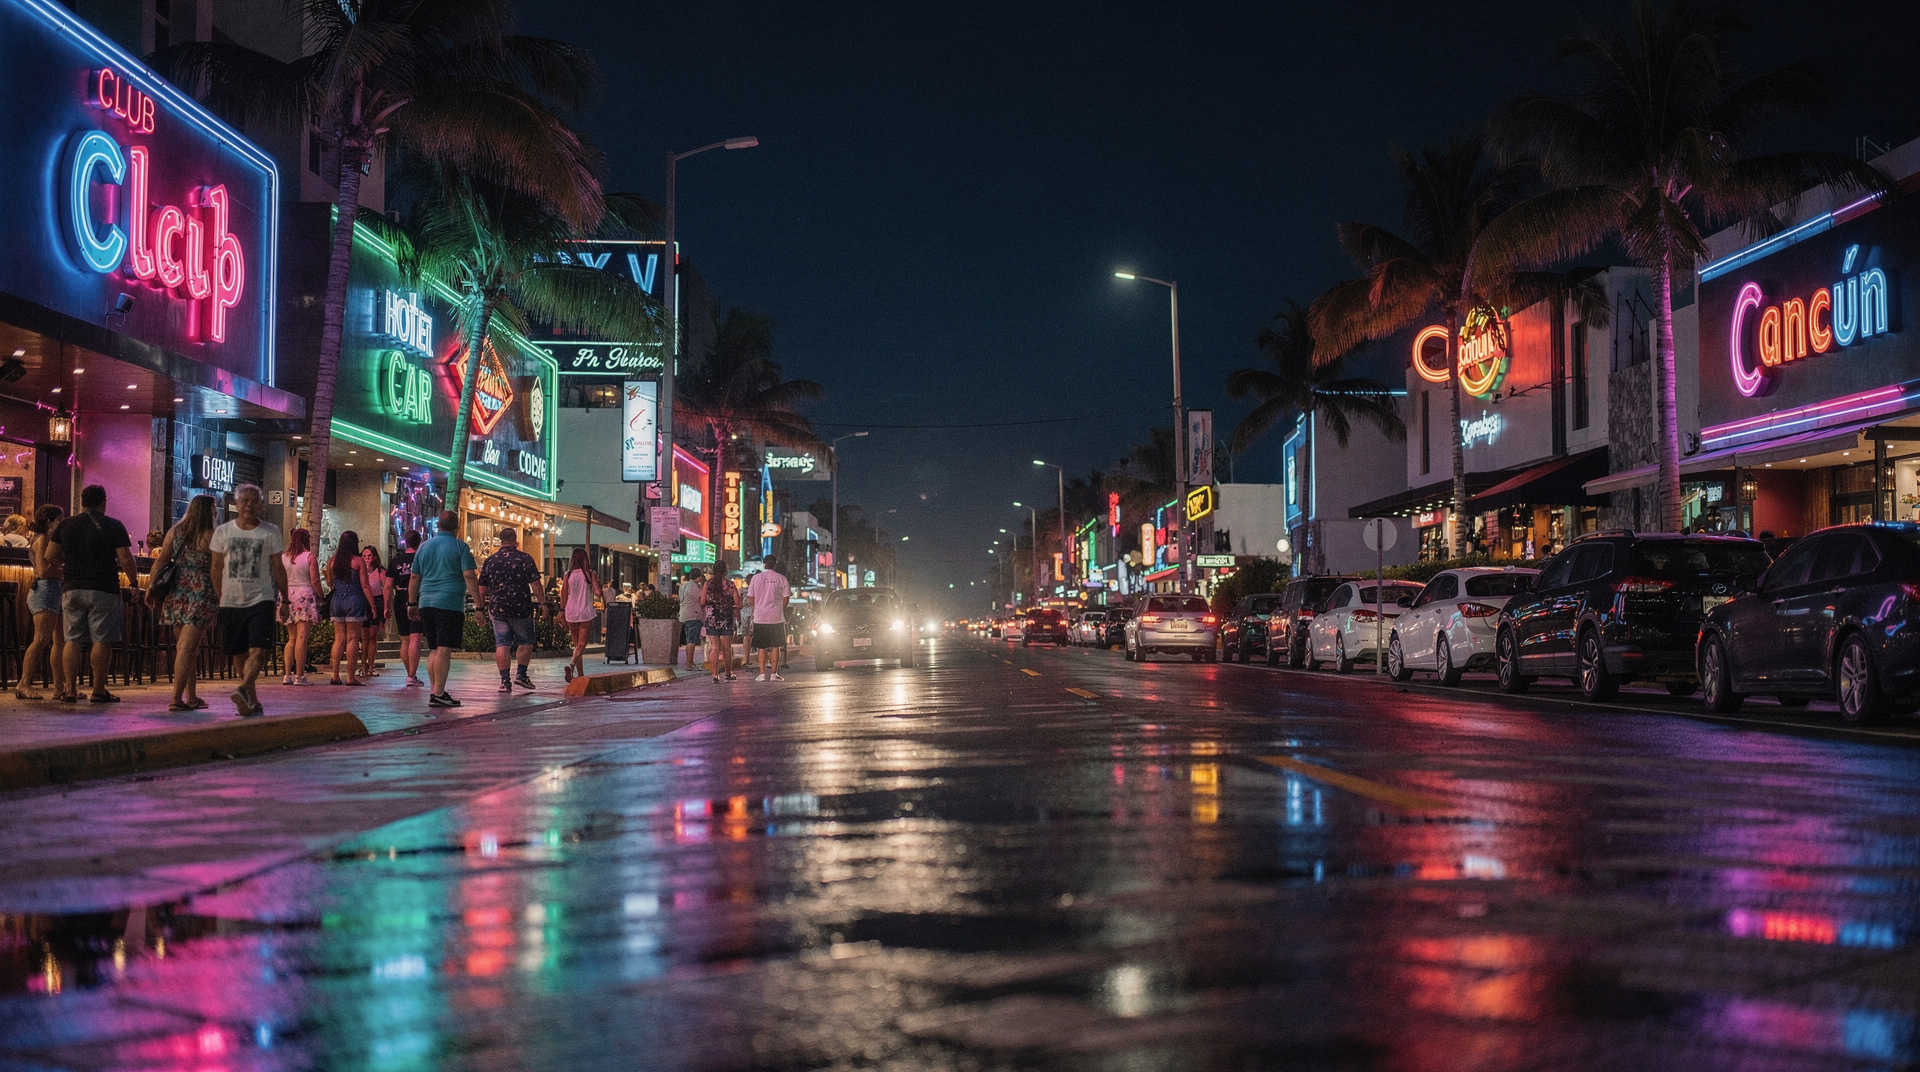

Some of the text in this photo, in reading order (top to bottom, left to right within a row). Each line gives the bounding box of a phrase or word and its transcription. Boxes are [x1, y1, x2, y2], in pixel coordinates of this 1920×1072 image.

[99, 67, 155, 133] CLUB
[1730, 244, 1888, 397] Cancún
[388, 349, 432, 425] CAR
